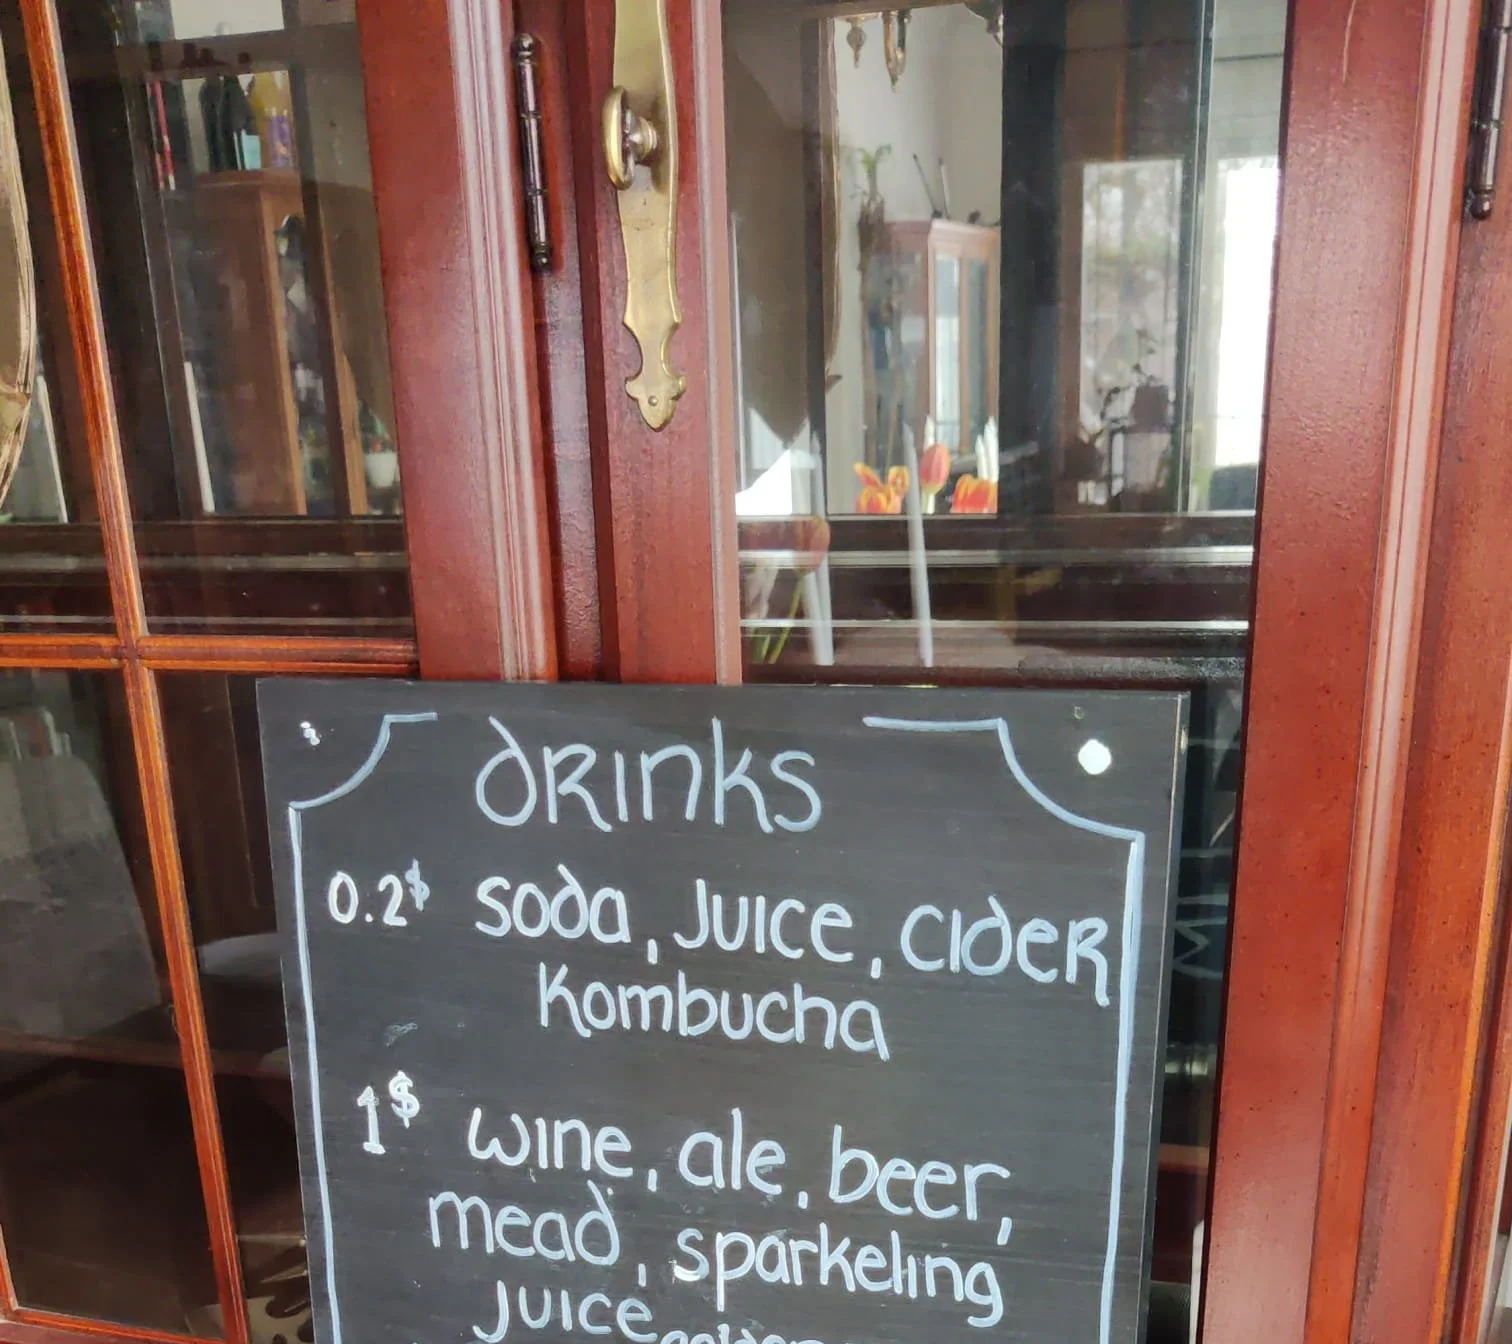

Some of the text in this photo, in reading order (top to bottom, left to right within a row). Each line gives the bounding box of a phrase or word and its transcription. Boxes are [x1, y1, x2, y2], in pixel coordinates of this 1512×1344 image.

[327, 859, 430, 927] 0.2$
[357, 1070, 420, 1154] 1$
[828, 1124, 1013, 1246] beer,
